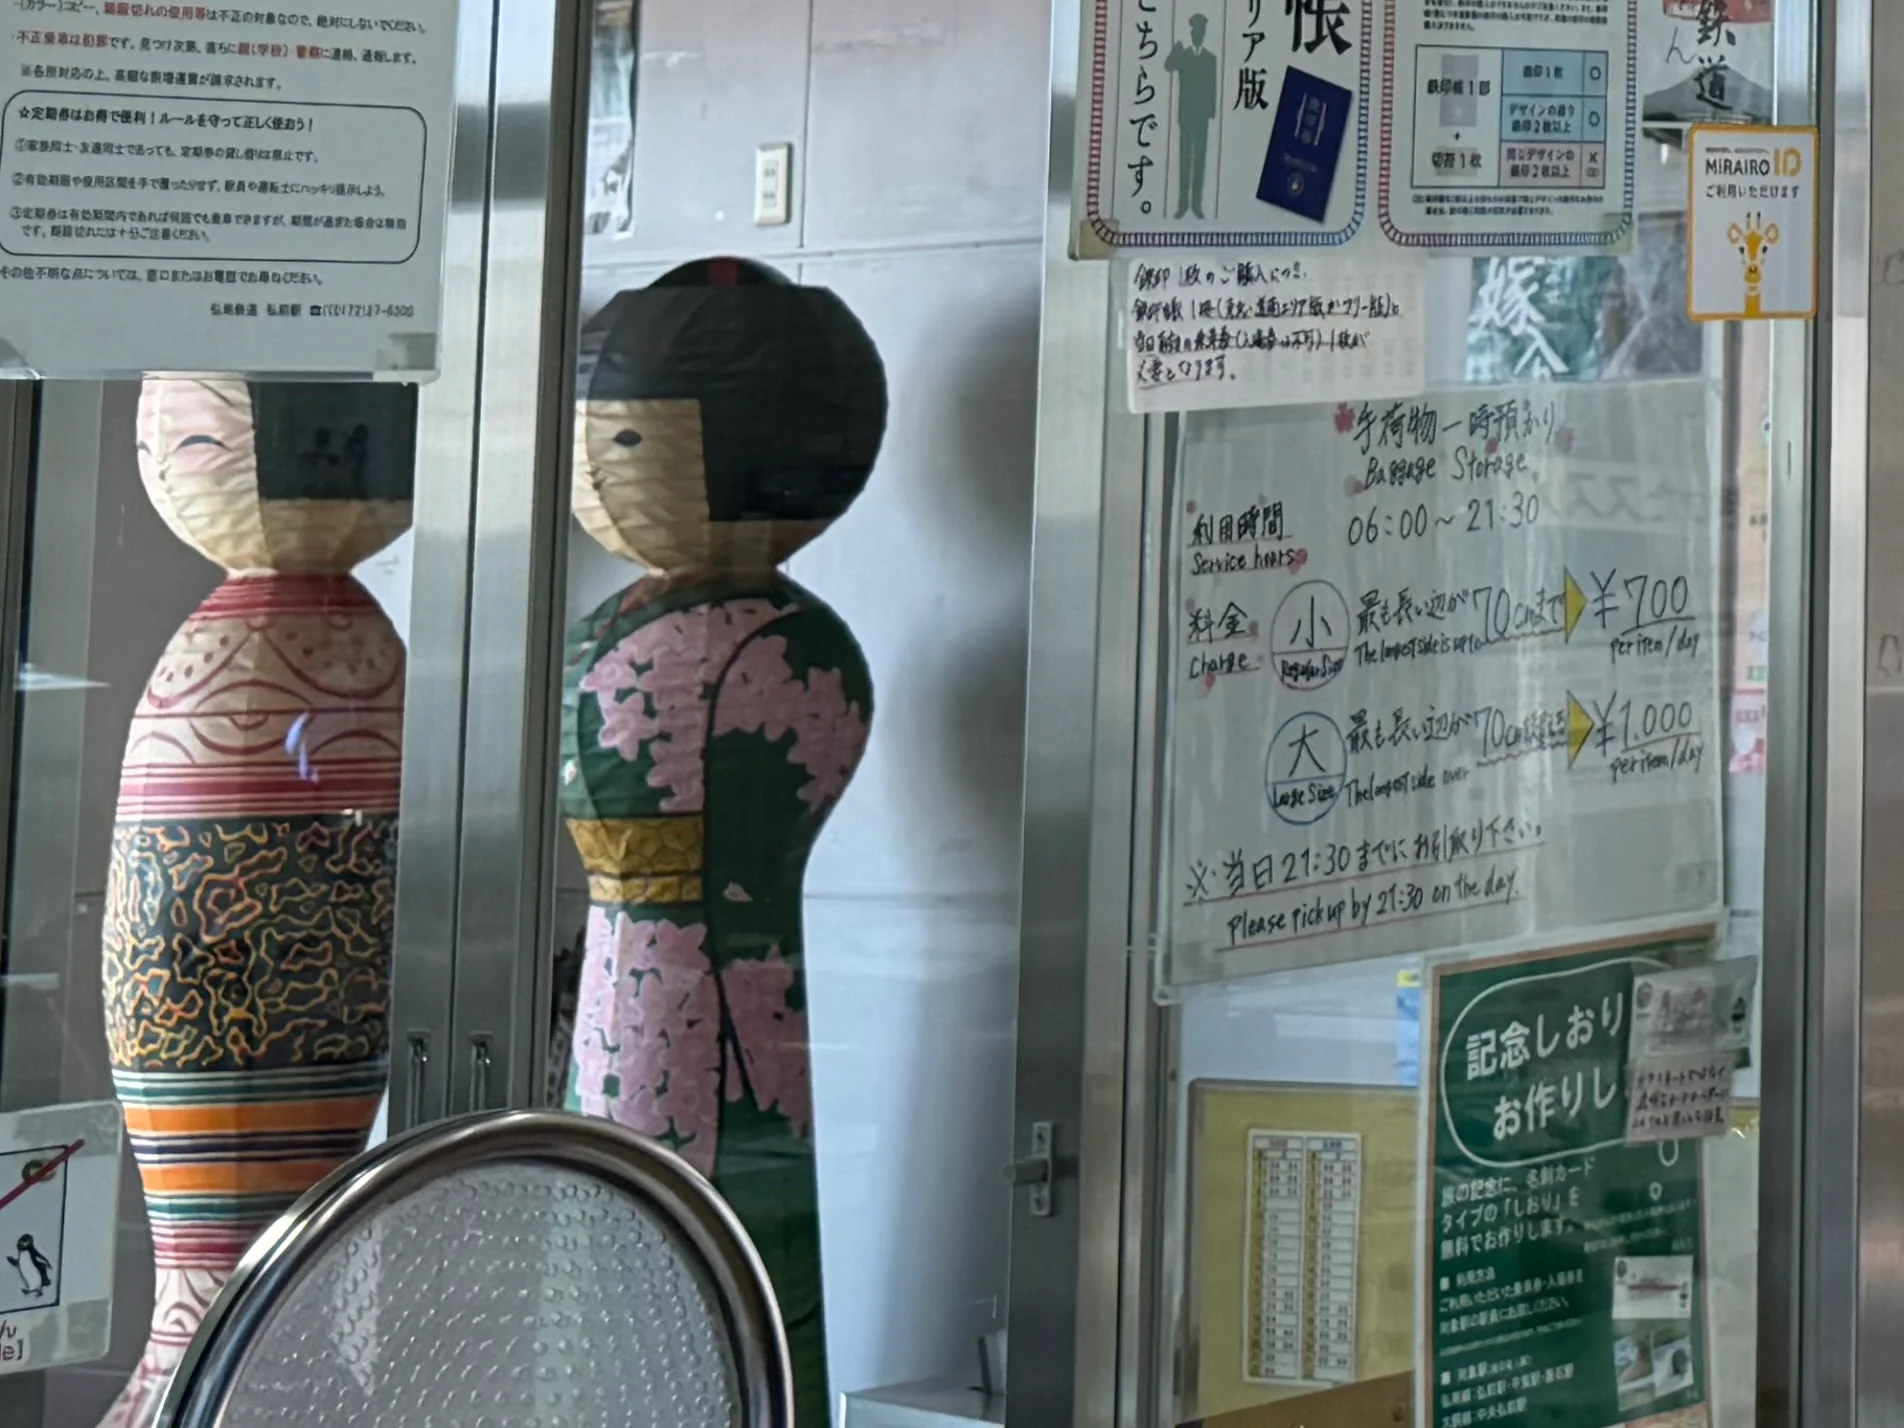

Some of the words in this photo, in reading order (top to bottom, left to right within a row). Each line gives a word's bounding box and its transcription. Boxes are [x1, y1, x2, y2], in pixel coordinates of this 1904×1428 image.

[1705, 157, 1771, 177] MIRAIRO
[1353, 399, 1557, 455] 手荷物一時預かり
[1363, 452, 1437, 491] Baggage
[1451, 445, 1528, 482] Storage
[1190, 500, 1286, 548] 利用時間
[1188, 600, 1248, 640] 料金
[1292, 595, 1332, 648] 小
[1288, 726, 1326, 777] 大
[1375, 881, 1425, 915] 21:30
[1465, 992, 1625, 1082] 記念しおり
